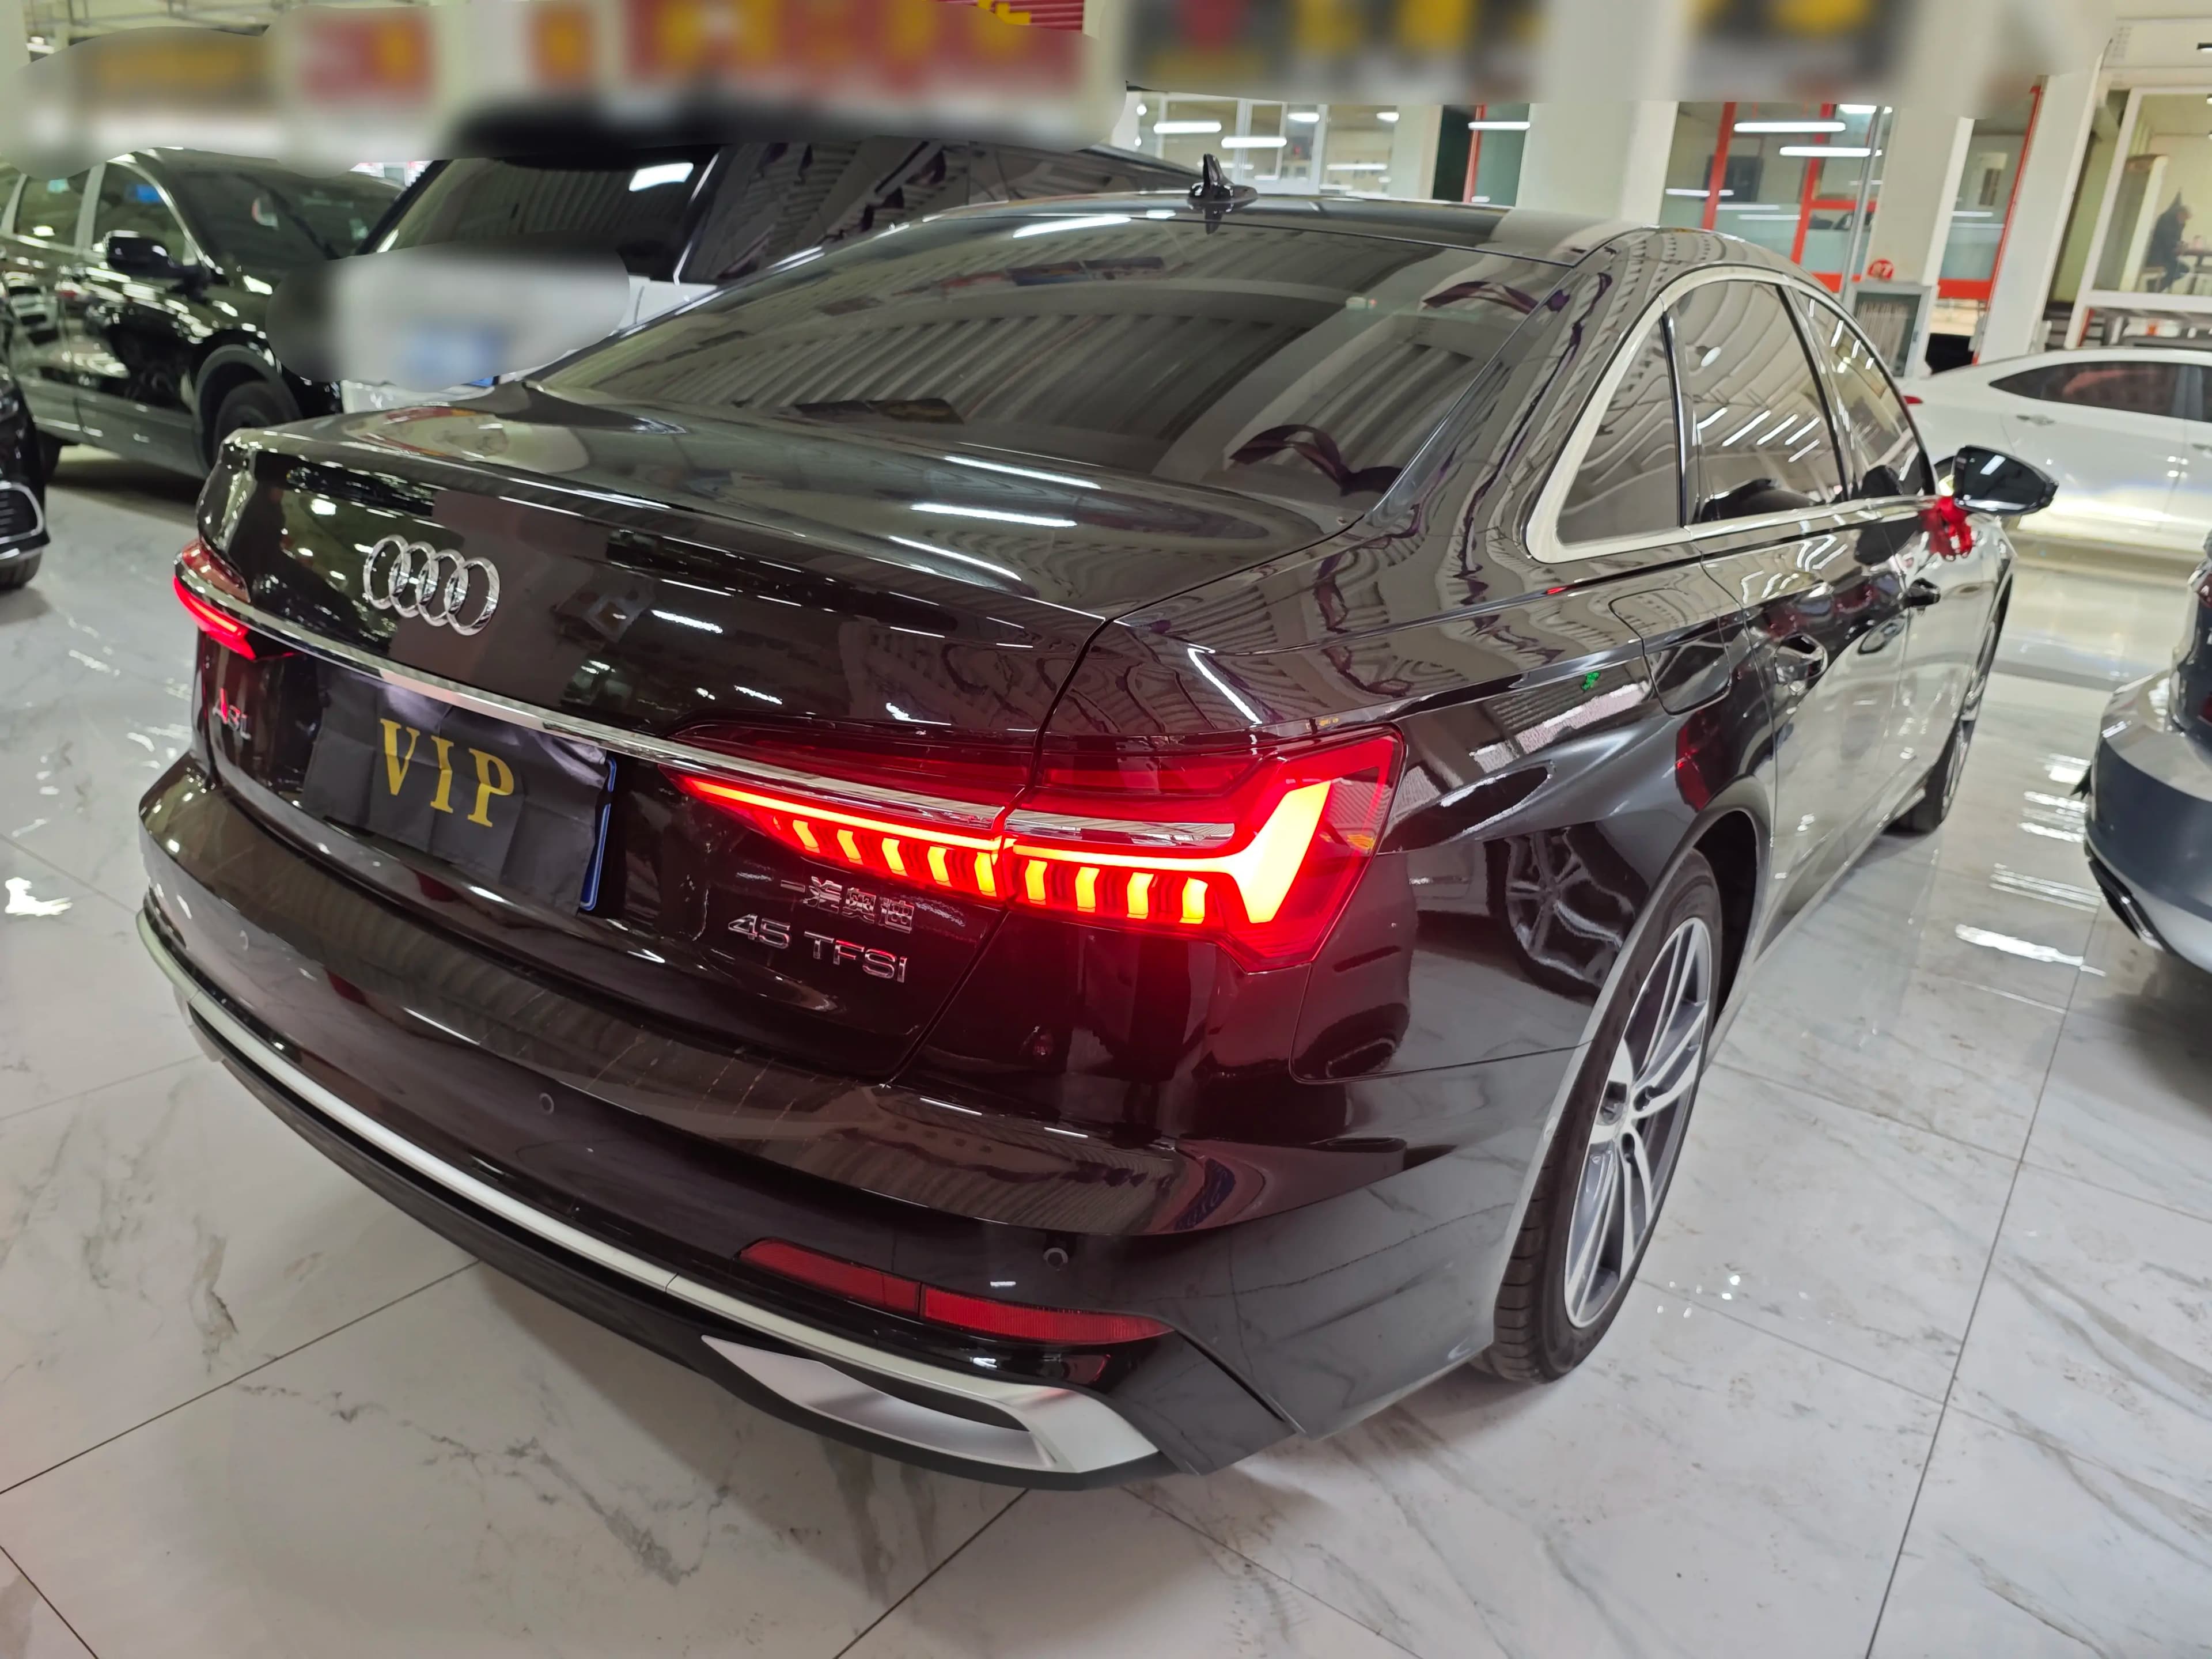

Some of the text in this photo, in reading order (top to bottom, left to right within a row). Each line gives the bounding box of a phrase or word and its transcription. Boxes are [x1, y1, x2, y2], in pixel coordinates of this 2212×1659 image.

[380, 718, 514, 828] VIP
[780, 876, 915, 934] 一汽奥迪
[728, 913, 908, 983] 45 TFSI
